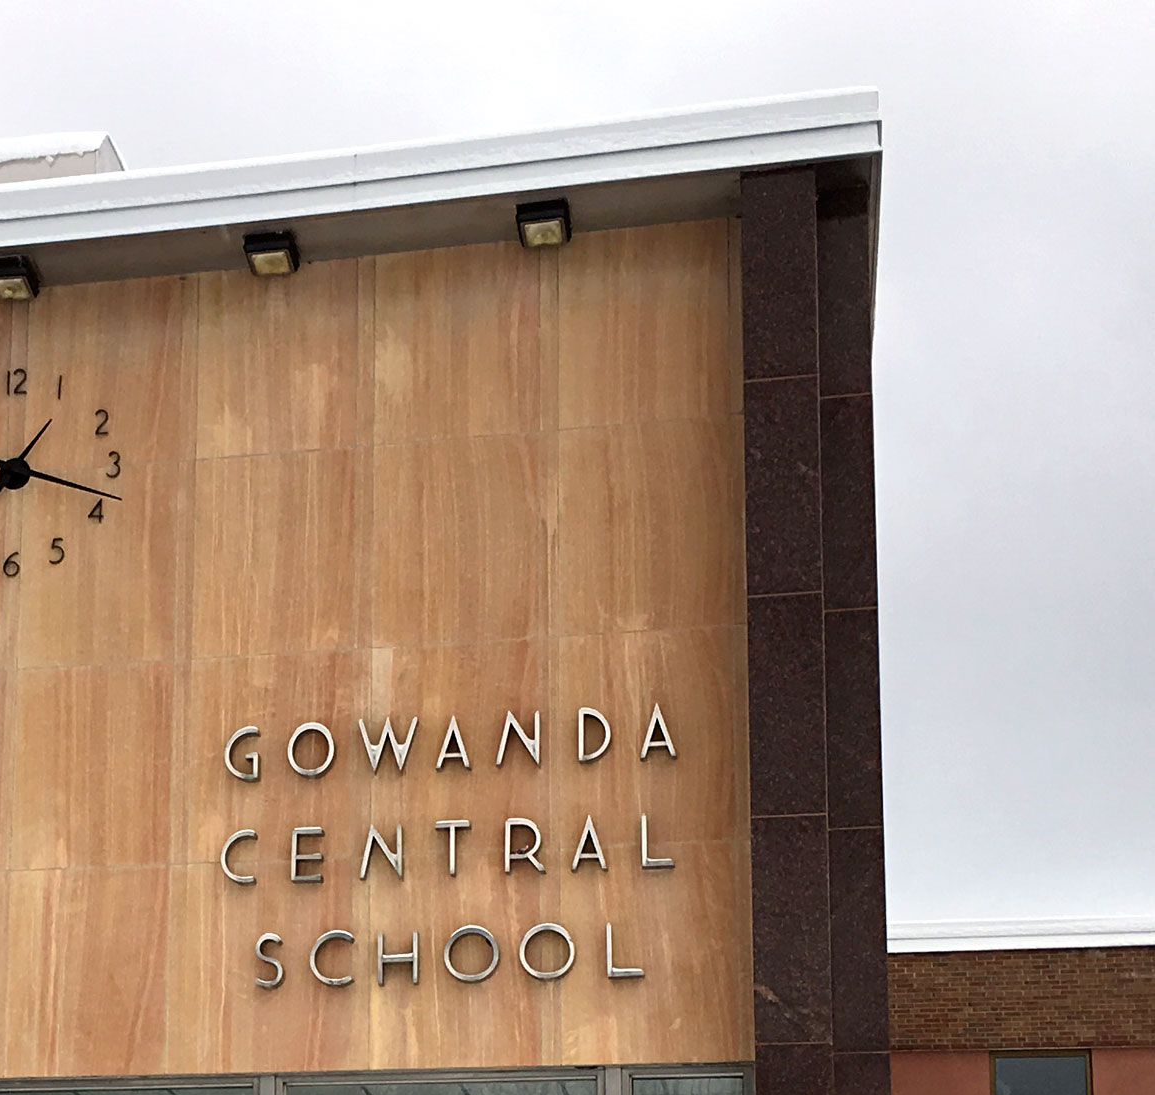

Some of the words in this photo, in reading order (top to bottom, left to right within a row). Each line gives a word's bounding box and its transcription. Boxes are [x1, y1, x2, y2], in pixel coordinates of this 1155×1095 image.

[6, 368, 28, 396] 12
[57, 375, 63, 400] 1
[95, 409, 109, 436] 2
[106, 451, 121, 478] 3
[87, 498, 104, 524] 4
[2, 551, 20, 577] 6
[49, 537, 65, 565] 5
[224, 702, 677, 782] GOWANDA
[220, 813, 675, 885] CENTRAL
[255, 922, 645, 989] SCHOOL
